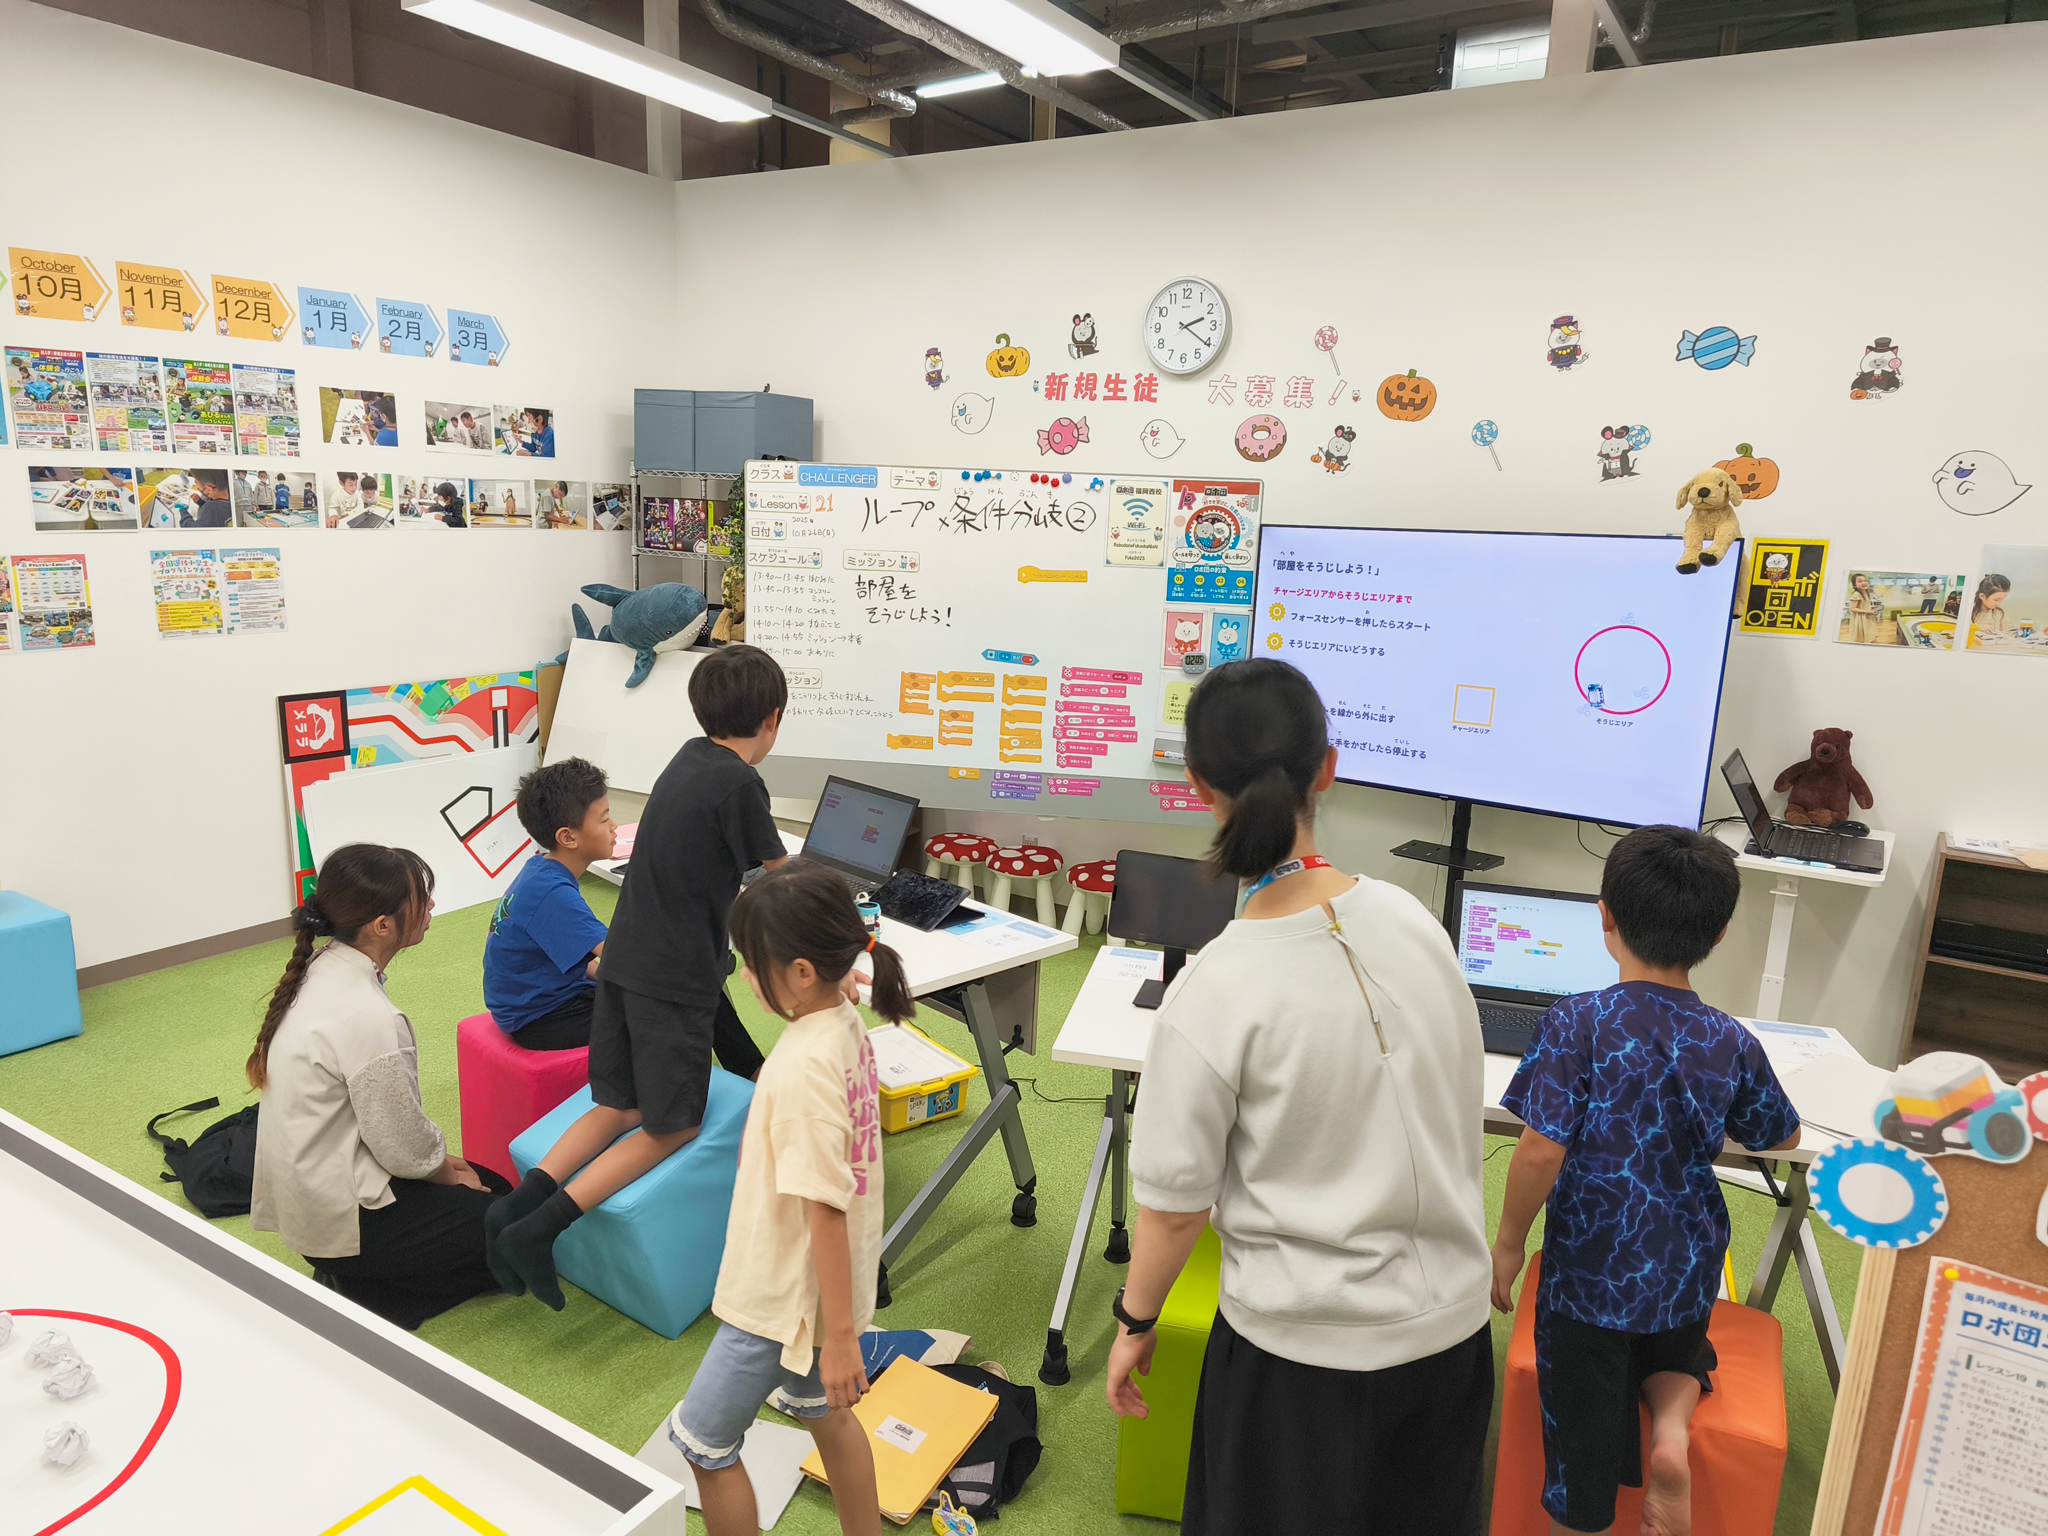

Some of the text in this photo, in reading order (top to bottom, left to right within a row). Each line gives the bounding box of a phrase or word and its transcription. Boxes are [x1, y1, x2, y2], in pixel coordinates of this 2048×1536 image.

[20, 256, 76, 274] October
[119, 268, 183, 287] November
[19, 273, 82, 302] 10月
[215, 281, 272, 299] December
[1182, 287, 1193, 300] 12
[125, 285, 182, 313] 11月
[306, 295, 348, 311] January
[1169, 293, 1177, 305] 11
[1199, 291, 1204, 304] 1
[219, 298, 272, 325] 12月
[381, 304, 423, 320] February
[1158, 306, 1169, 318] 10
[1206, 302, 1214, 315] 2
[312, 310, 347, 333] 1月
[457, 316, 485, 329] March
[1154, 321, 1162, 334] 9
[1209, 320, 1217, 332] 3
[388, 319, 421, 341] 2月
[458, 329, 488, 351] 3月
[1157, 338, 1165, 349] 8
[1167, 349, 1175, 361] 7
[1179, 352, 1188, 364] 6
[1194, 348, 1201, 360] 5
[1044, 371, 1159, 402] 新規生徒
[750, 468, 877, 485] クラス CHALLENGER
[893, 475, 926, 487] テーマ
[1135, 488, 1162, 496] 福岡西校
[760, 498, 798, 510] Lesson
[815, 493, 834, 512] 21
[751, 527, 771, 538] 日付
[748, 552, 808, 565] スケジュール
[847, 556, 897, 568] ミッション
[1271, 559, 1381, 577] 「部屋をそうじしよう！」
[854, 574, 917, 601] 部屋を
[1273, 586, 1413, 604] チャージエリアからそうじエリアまで
[1290, 612, 1431, 632] フォースセンサーを押したらスタート
[1746, 610, 1811, 630] OPEN
[1288, 639, 1386, 657] そうじエリアにいどうする
[1452, 725, 1490, 735] チャージエリア
[1596, 717, 1634, 728] そうじエリア
[1961, 1310, 2048, 1348] ロボ団
